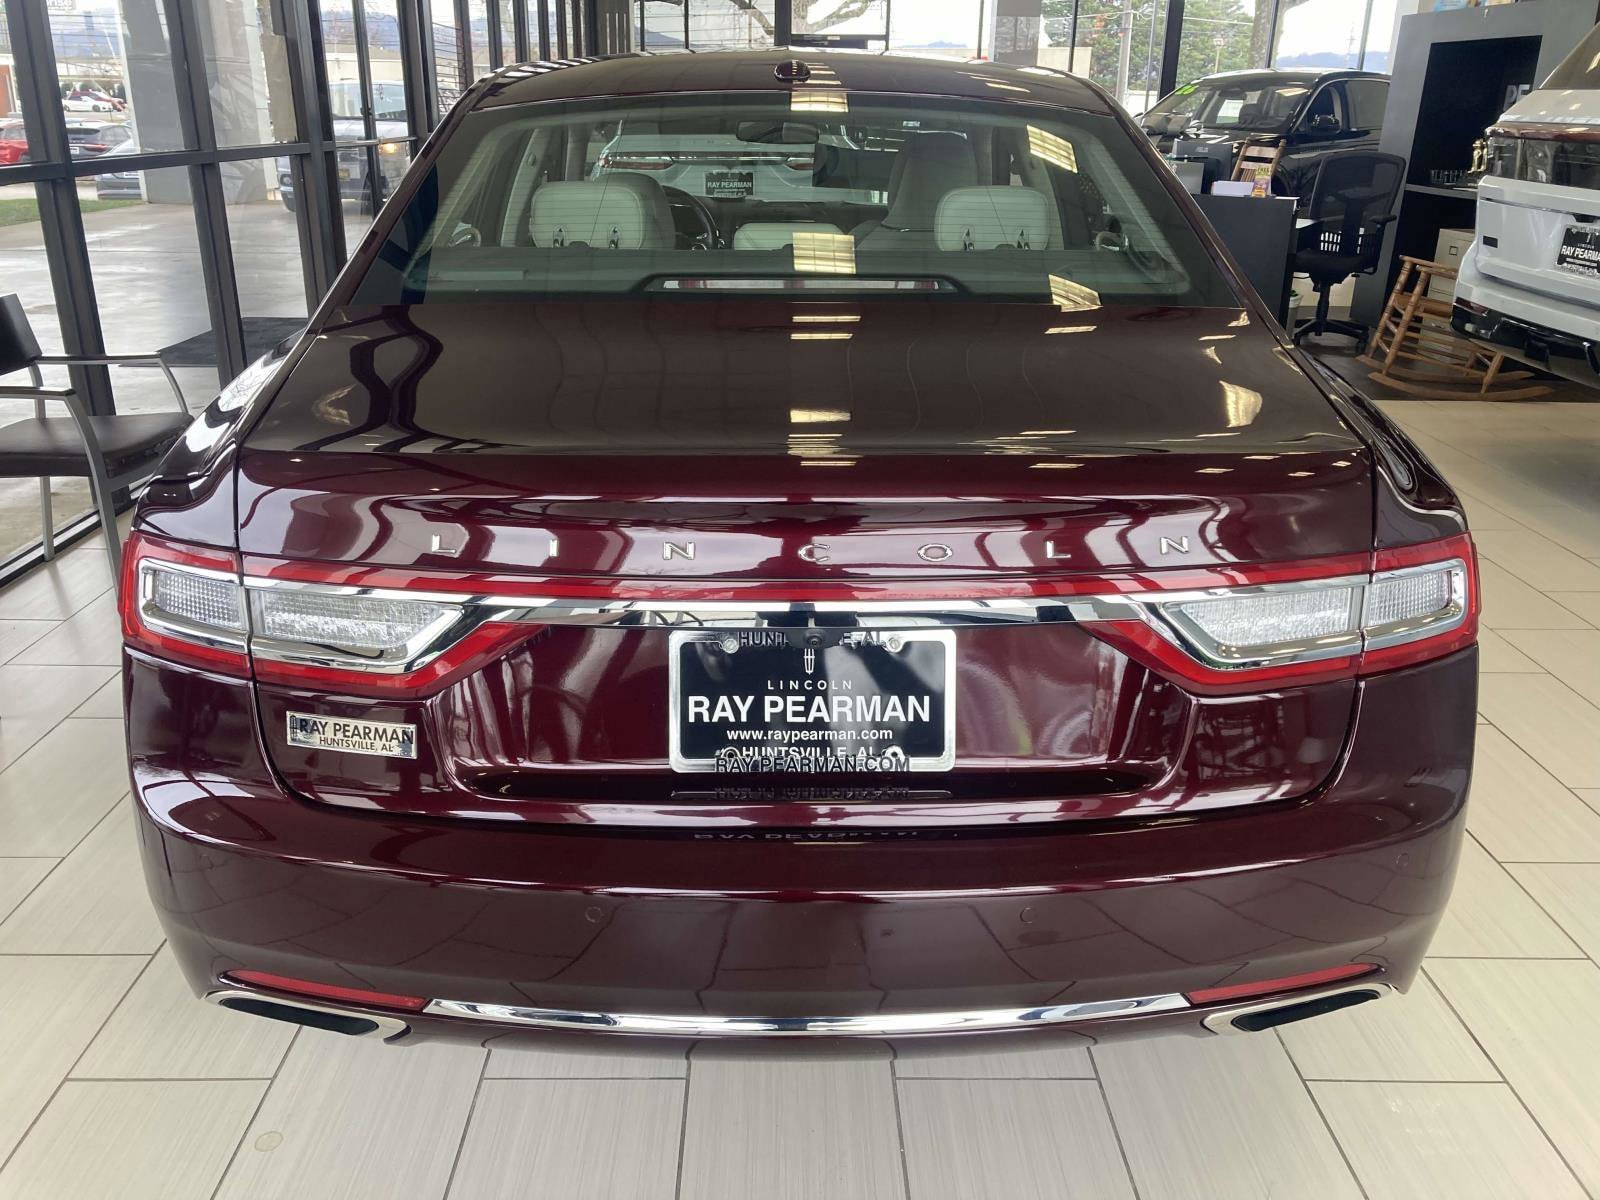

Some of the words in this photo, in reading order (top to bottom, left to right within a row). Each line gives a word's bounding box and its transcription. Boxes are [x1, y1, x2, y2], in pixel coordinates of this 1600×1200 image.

[1560, 245, 1575, 256] RAY
[767, 680, 853, 690] LINCOLN
[687, 695, 755, 723] RAY
[763, 695, 930, 723] PEARMAN
[299, 718, 328, 736] RAY
[333, 722, 414, 745] PEARMAN
[726, 727, 893, 742] www.raypearman.com
[319, 736, 378, 752] HUNTSVILLE,
[381, 744, 394, 753] AL
[716, 757, 754, 772] RAY
